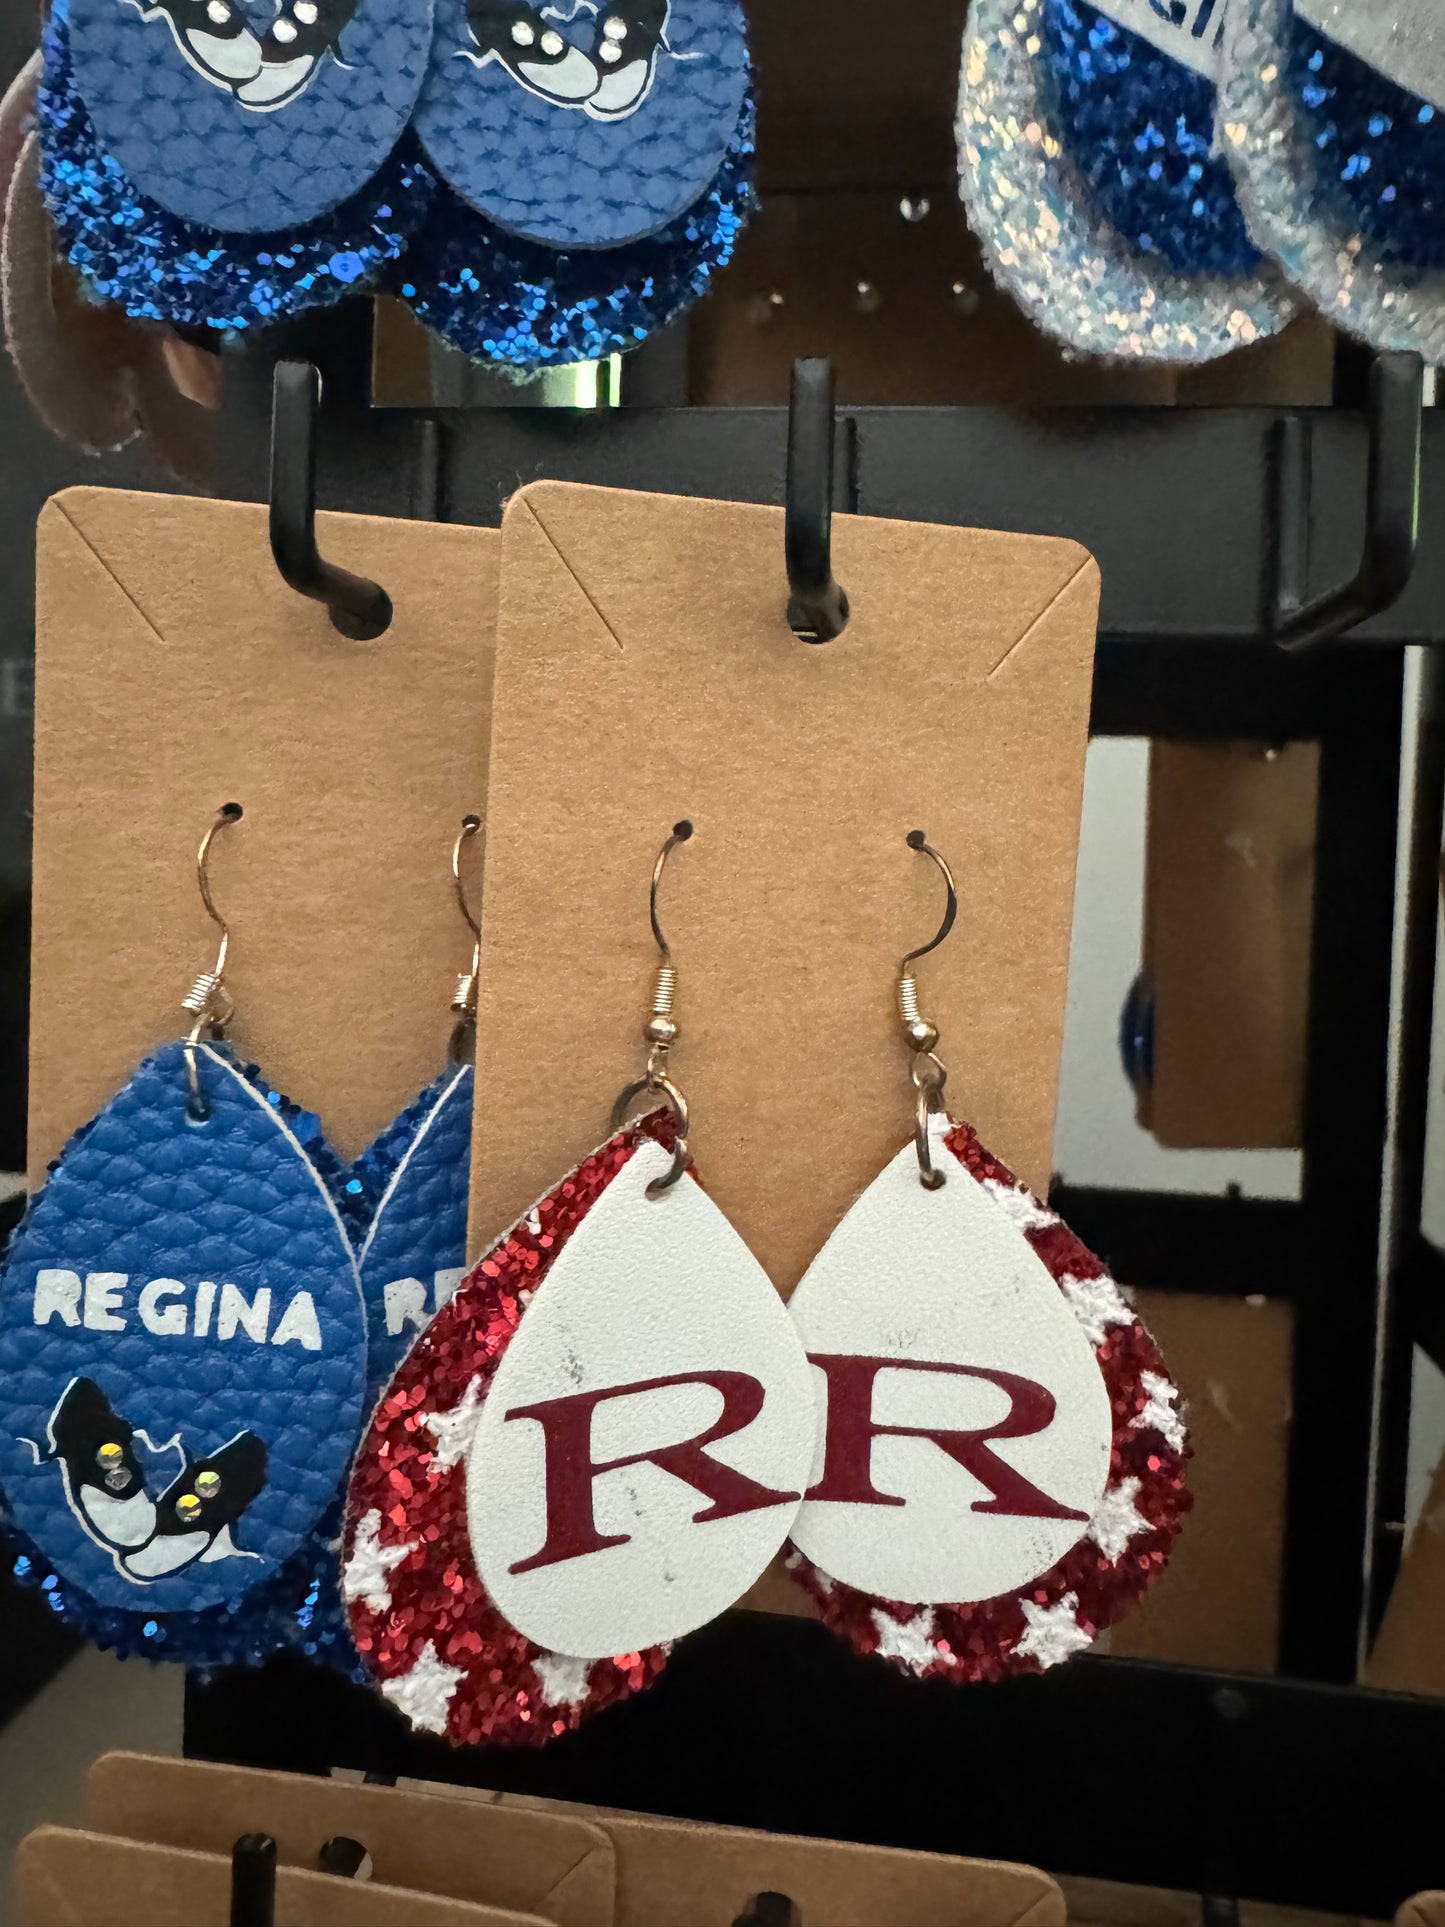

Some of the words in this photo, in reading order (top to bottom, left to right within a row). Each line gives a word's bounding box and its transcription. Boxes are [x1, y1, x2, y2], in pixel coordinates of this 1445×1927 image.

[33, 1269, 323, 1351] REGINA
[504, 1370, 801, 1574] R
[804, 1352, 1091, 1521] R
